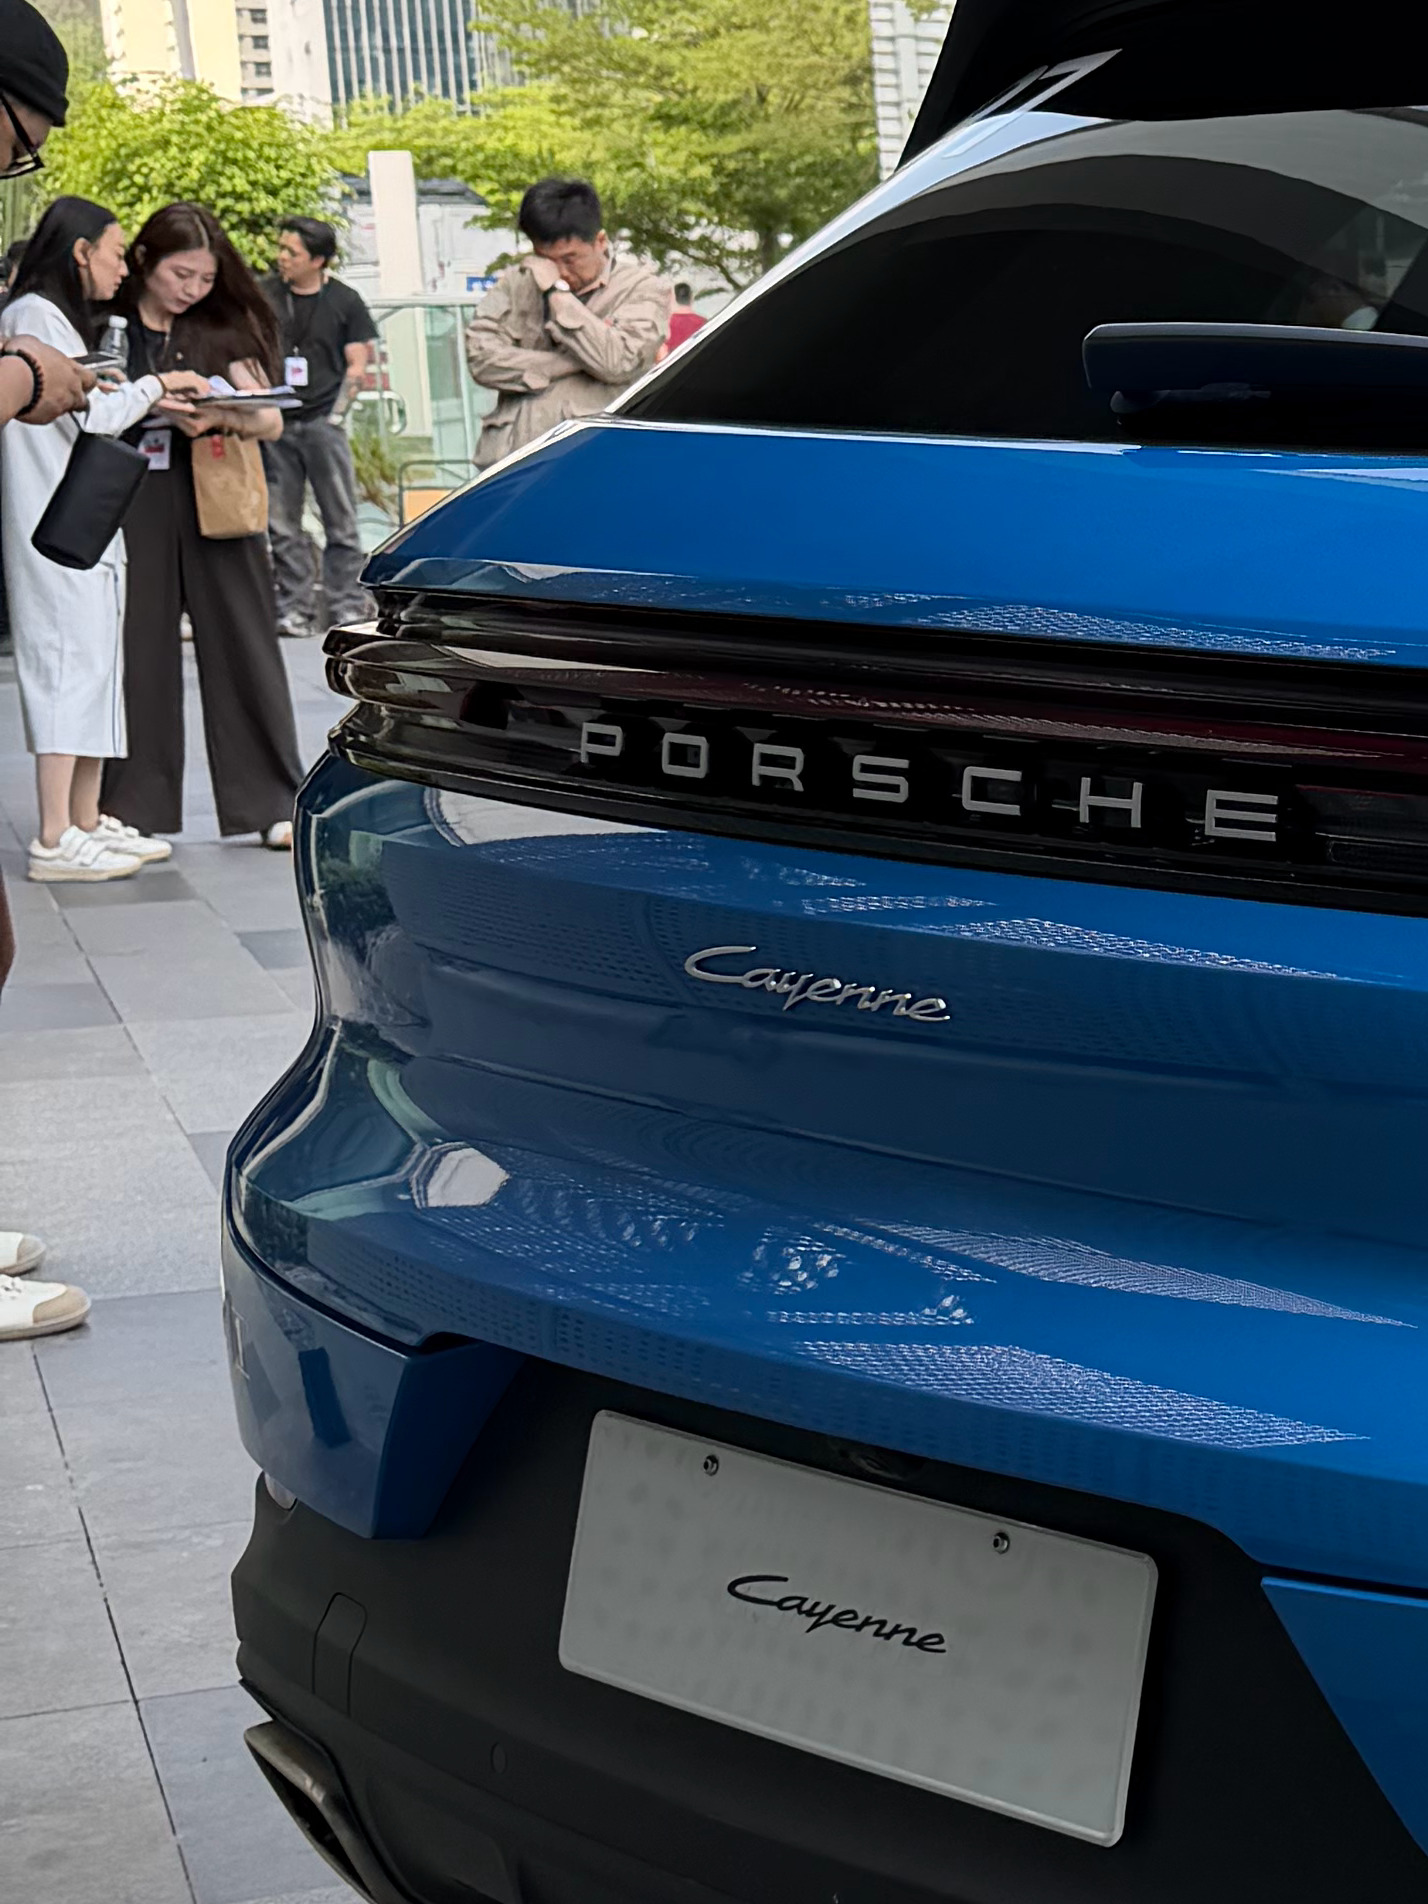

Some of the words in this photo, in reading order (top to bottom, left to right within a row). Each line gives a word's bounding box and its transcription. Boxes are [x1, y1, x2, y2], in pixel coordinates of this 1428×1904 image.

[579, 722, 1280, 843] PORSCHE
[683, 945, 951, 1023] Cayenne
[726, 1573, 947, 1655] Cayenne
